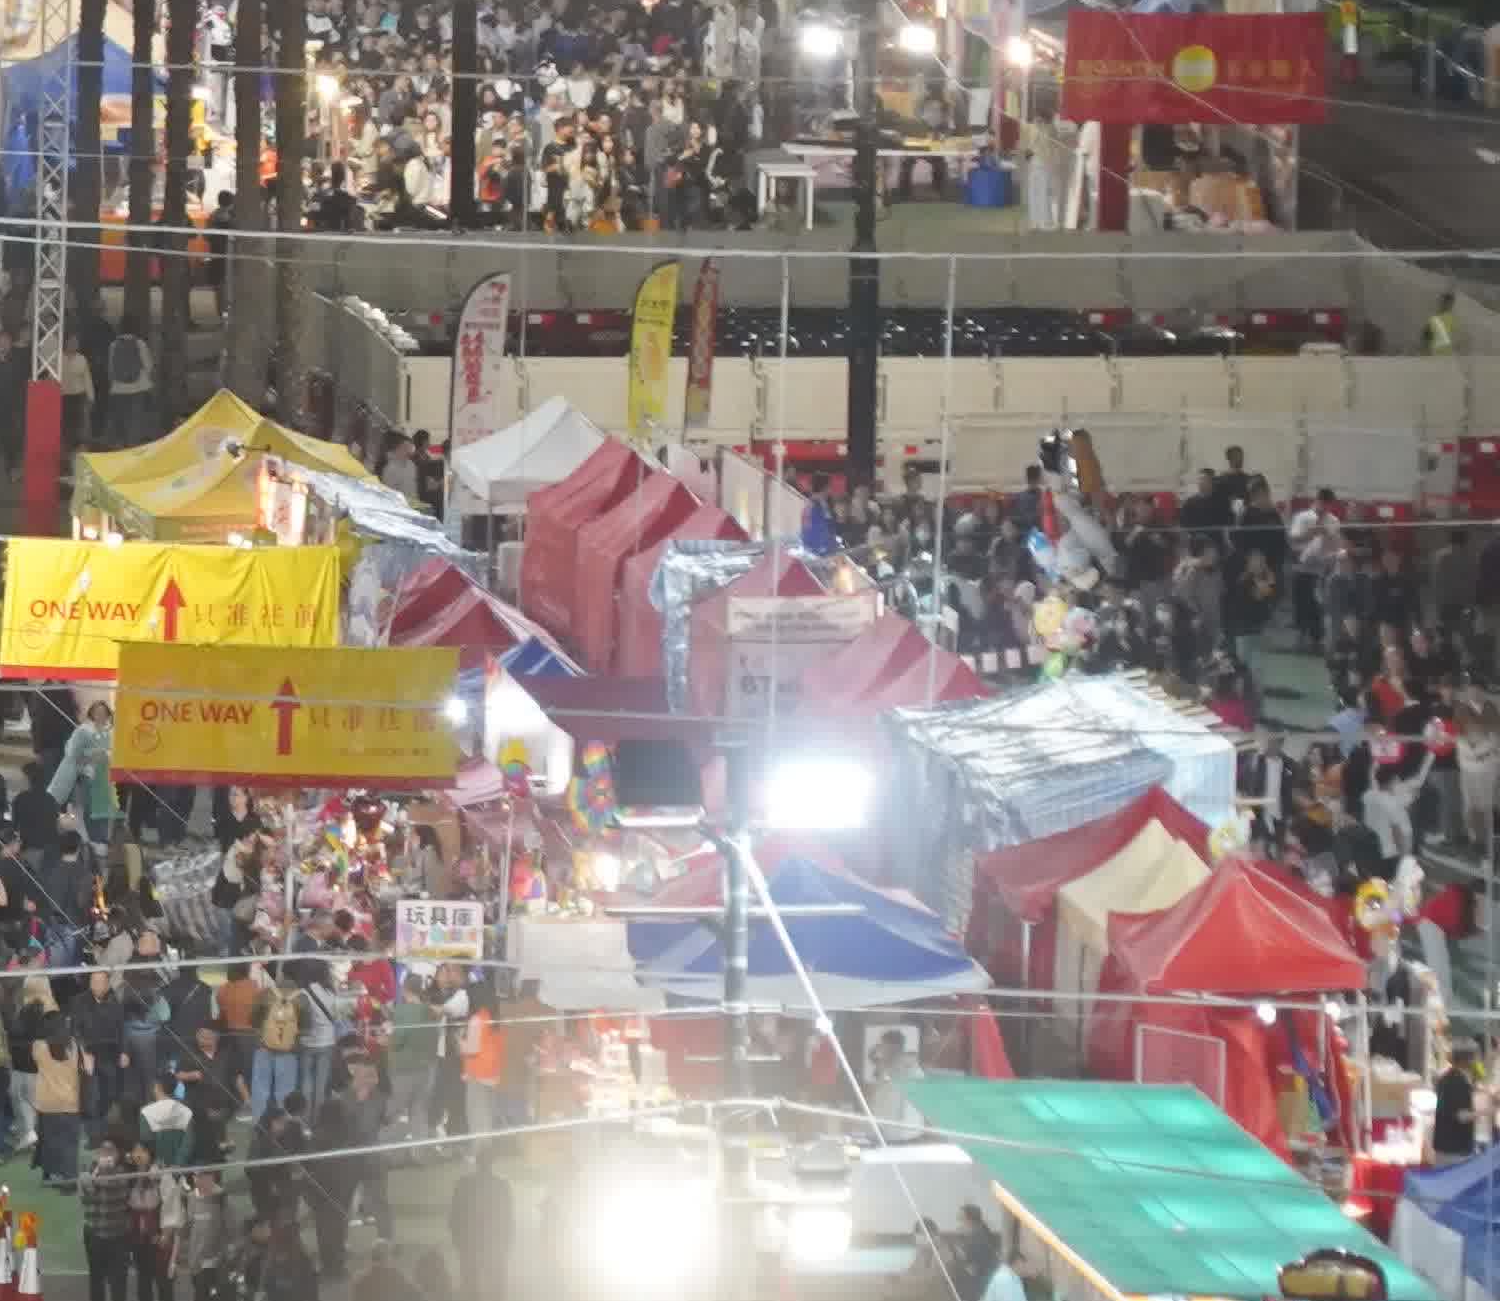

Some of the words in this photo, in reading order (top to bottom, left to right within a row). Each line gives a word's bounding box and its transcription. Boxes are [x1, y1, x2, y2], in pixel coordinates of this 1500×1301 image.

[29, 599, 82, 622] ONE
[86, 599, 141, 622] WAY
[140, 700, 195, 724] ONE
[200, 701, 255, 725] WAY
